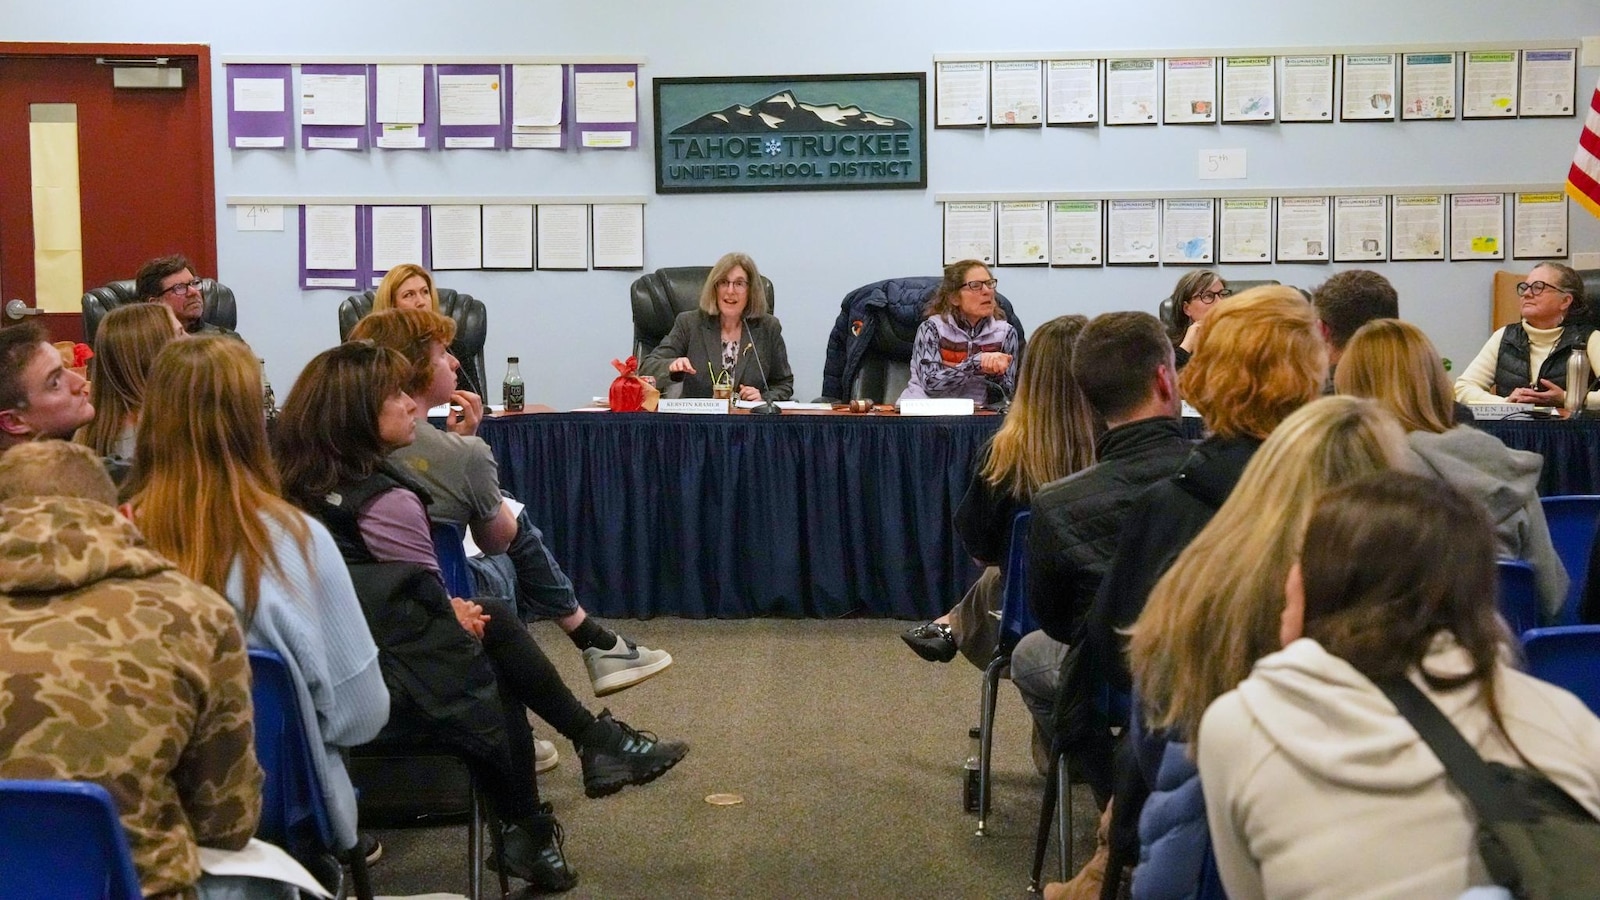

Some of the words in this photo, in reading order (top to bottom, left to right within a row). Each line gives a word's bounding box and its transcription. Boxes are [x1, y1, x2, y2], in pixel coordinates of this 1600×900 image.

[668, 137, 763, 159] TAHOE
[781, 134, 911, 157] TRUCKEE
[668, 164, 740, 180] UNIFIED
[746, 162, 823, 179] SCHOOL
[829, 160, 912, 177] DISTRICT
[1208, 154, 1229, 172] 5th
[246, 205, 270, 227] 4th
